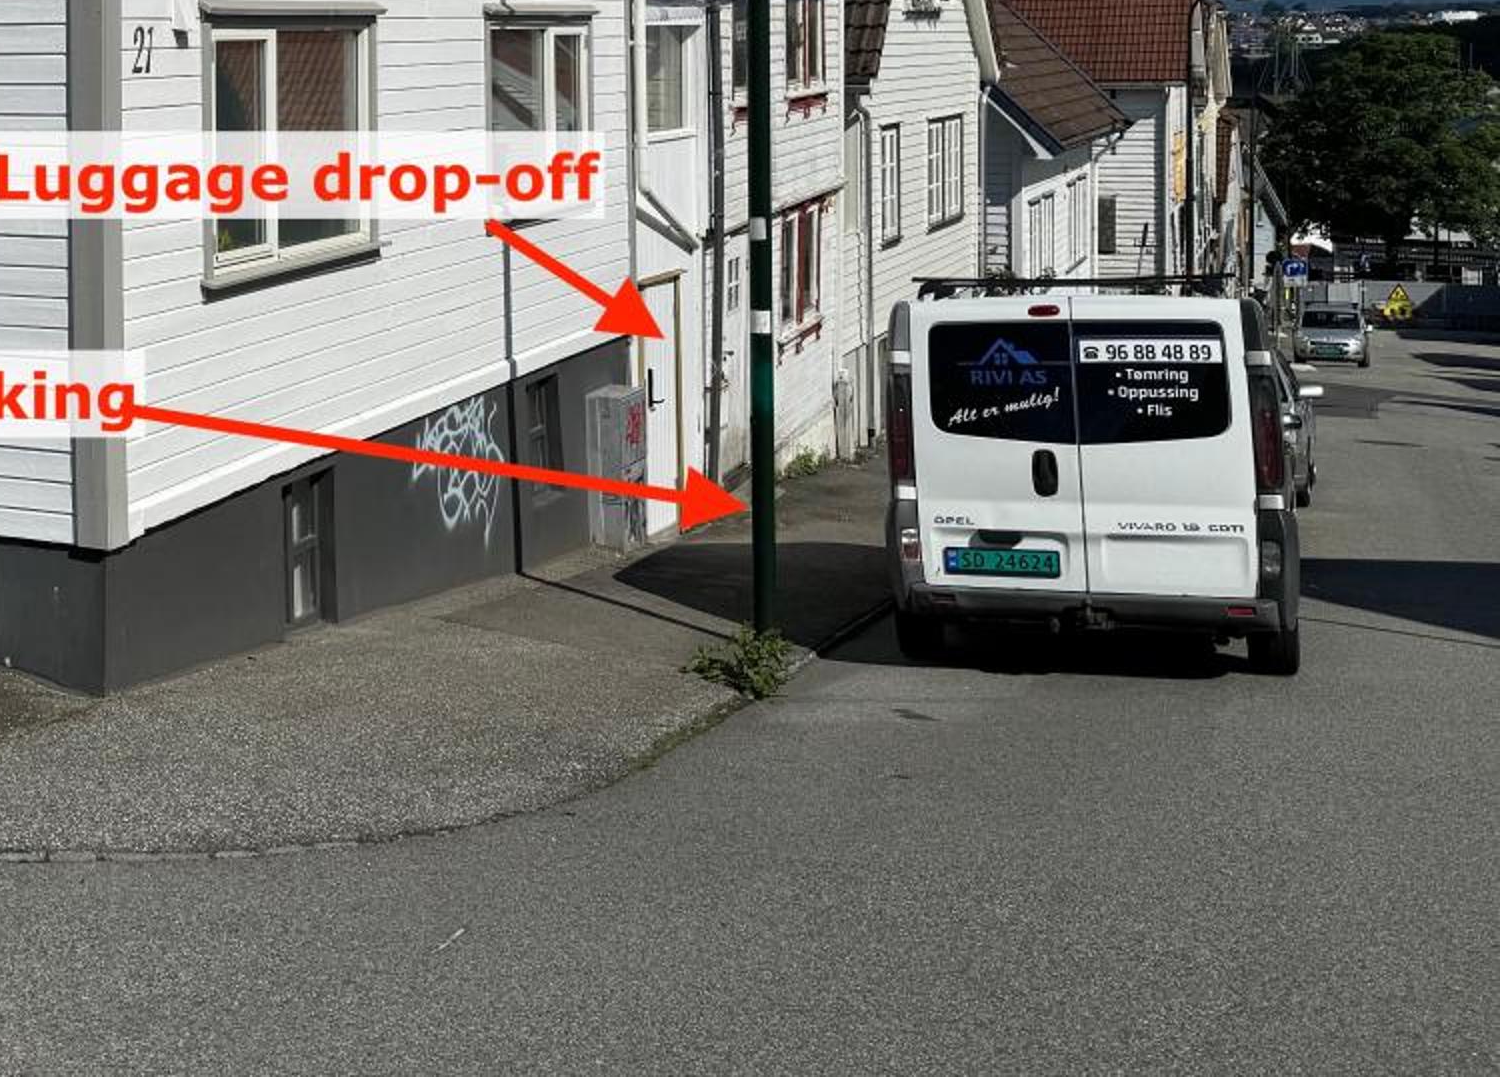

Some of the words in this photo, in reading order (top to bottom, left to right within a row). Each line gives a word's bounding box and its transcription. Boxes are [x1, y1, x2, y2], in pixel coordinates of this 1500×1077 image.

[132, 26, 154, 74] 21
[1106, 344, 1129, 360] 96
[1133, 344, 1156, 360] 88
[1161, 344, 1184, 360] 48
[1189, 344, 1212, 360] 89
[970, 370, 1013, 385] RIVI
[1020, 370, 1047, 384] AS
[1125, 368, 1189, 384] Tømring
[1117, 385, 1199, 402] Oppussing
[982, 407, 1000, 418] er
[1004, 386, 1060, 412] mulig!
[1147, 404, 1173, 416] Flis
[933, 516, 975, 526] OPEL
[1117, 522, 1177, 532] VIVARO
[961, 552, 985, 568] SD
[995, 553, 1054, 573] 24624
